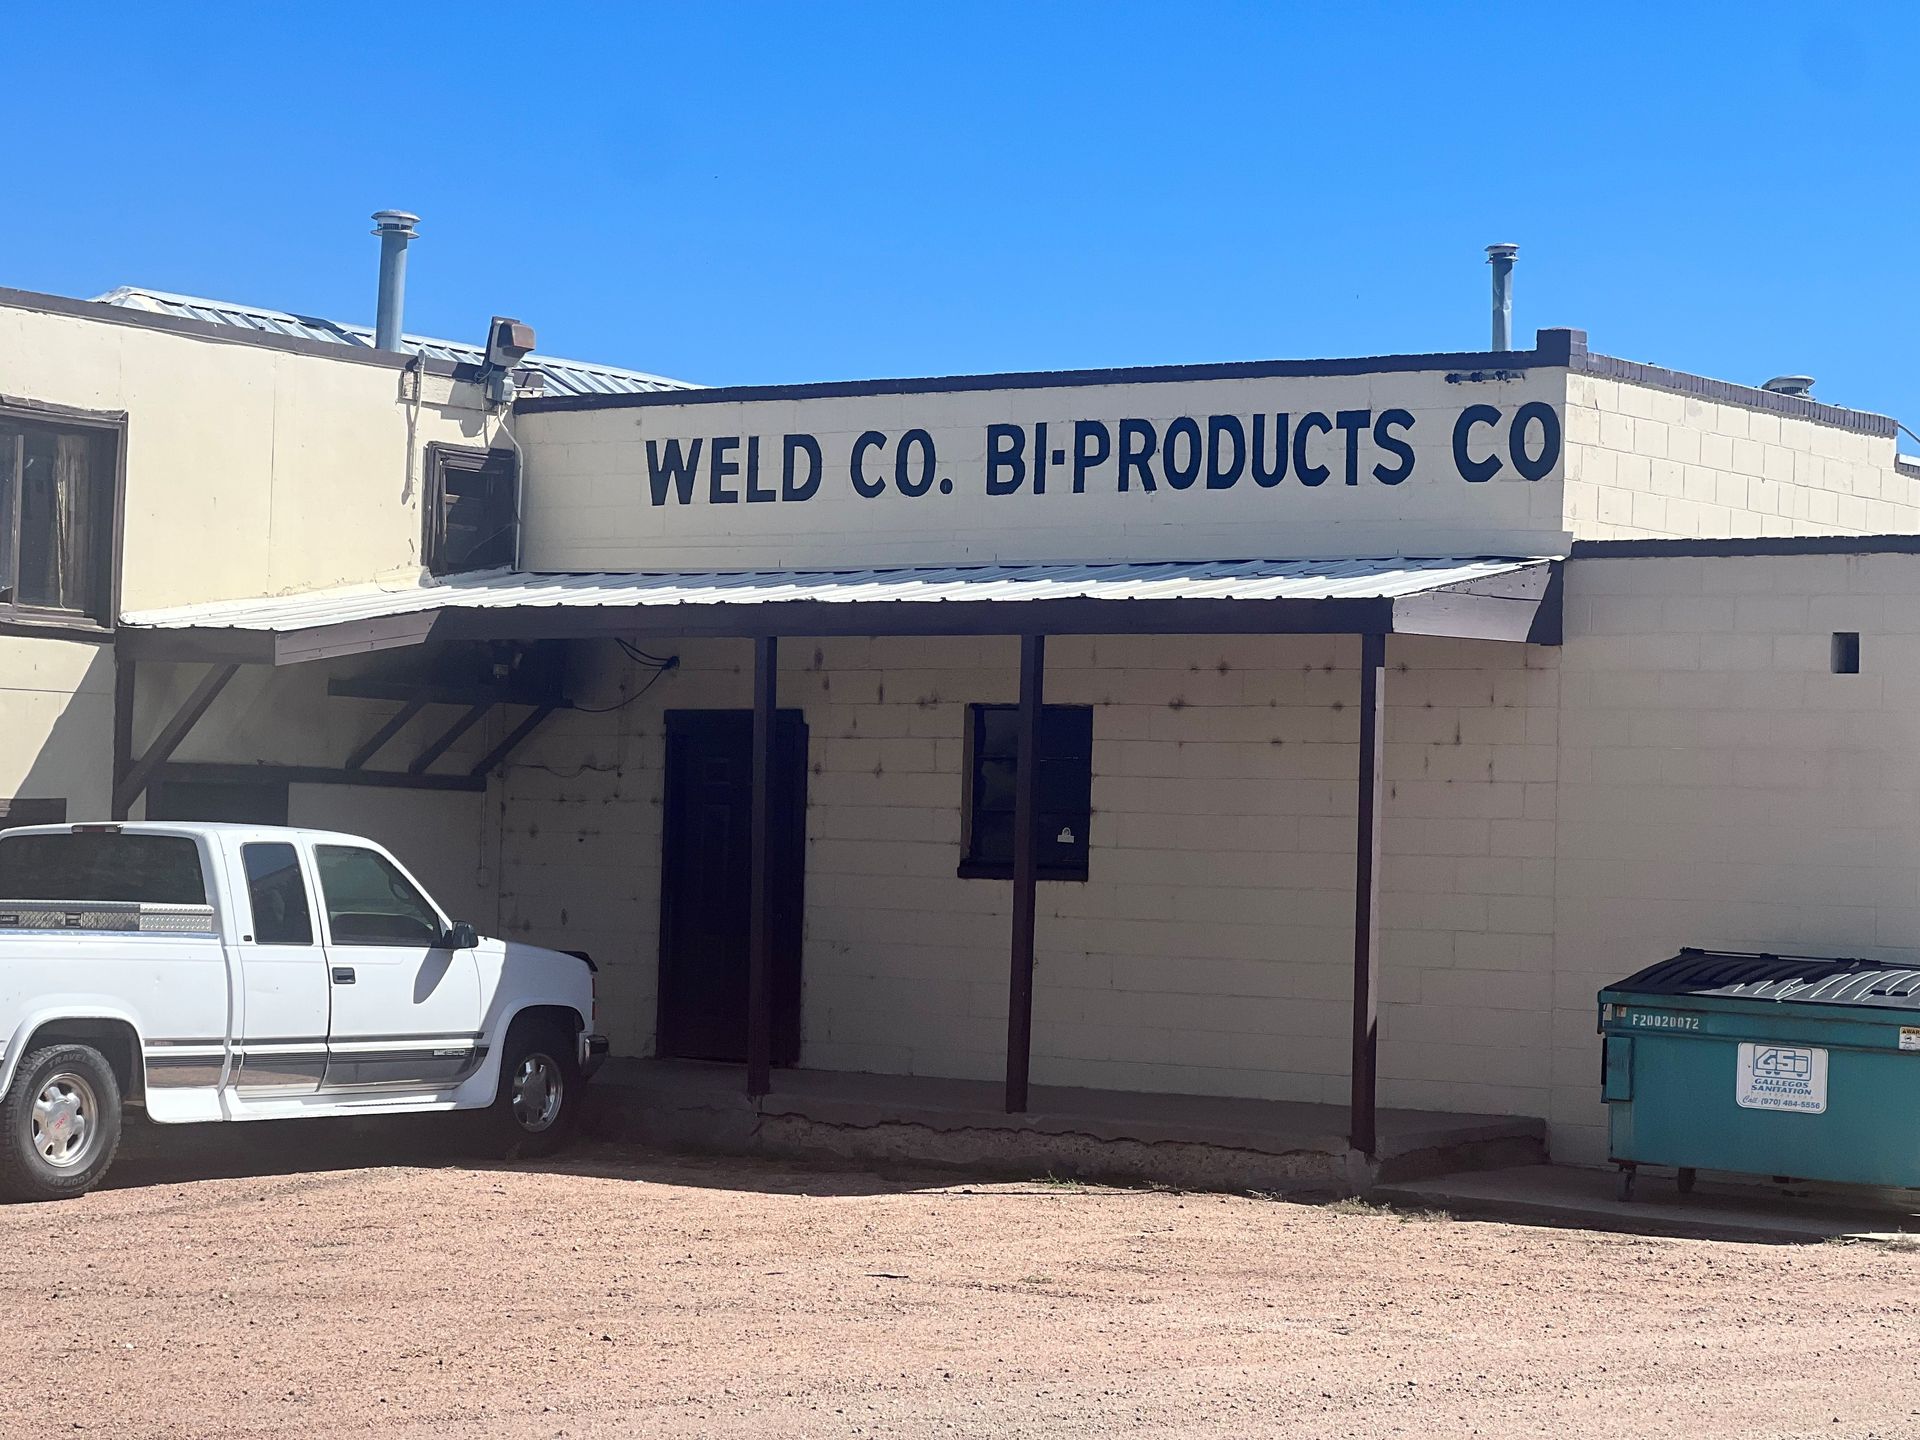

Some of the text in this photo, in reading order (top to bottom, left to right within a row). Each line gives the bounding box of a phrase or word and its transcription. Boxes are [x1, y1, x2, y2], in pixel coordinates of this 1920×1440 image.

[646, 402, 1561, 507] WELD CO. BI-PRODUCTS CO
[1754, 1078, 1809, 1089] GALLEGOS
[1751, 1084, 1812, 1096] SANITATION
[1761, 1097, 1780, 1107] (970)
[1782, 1099, 1821, 1110] 484-5556
